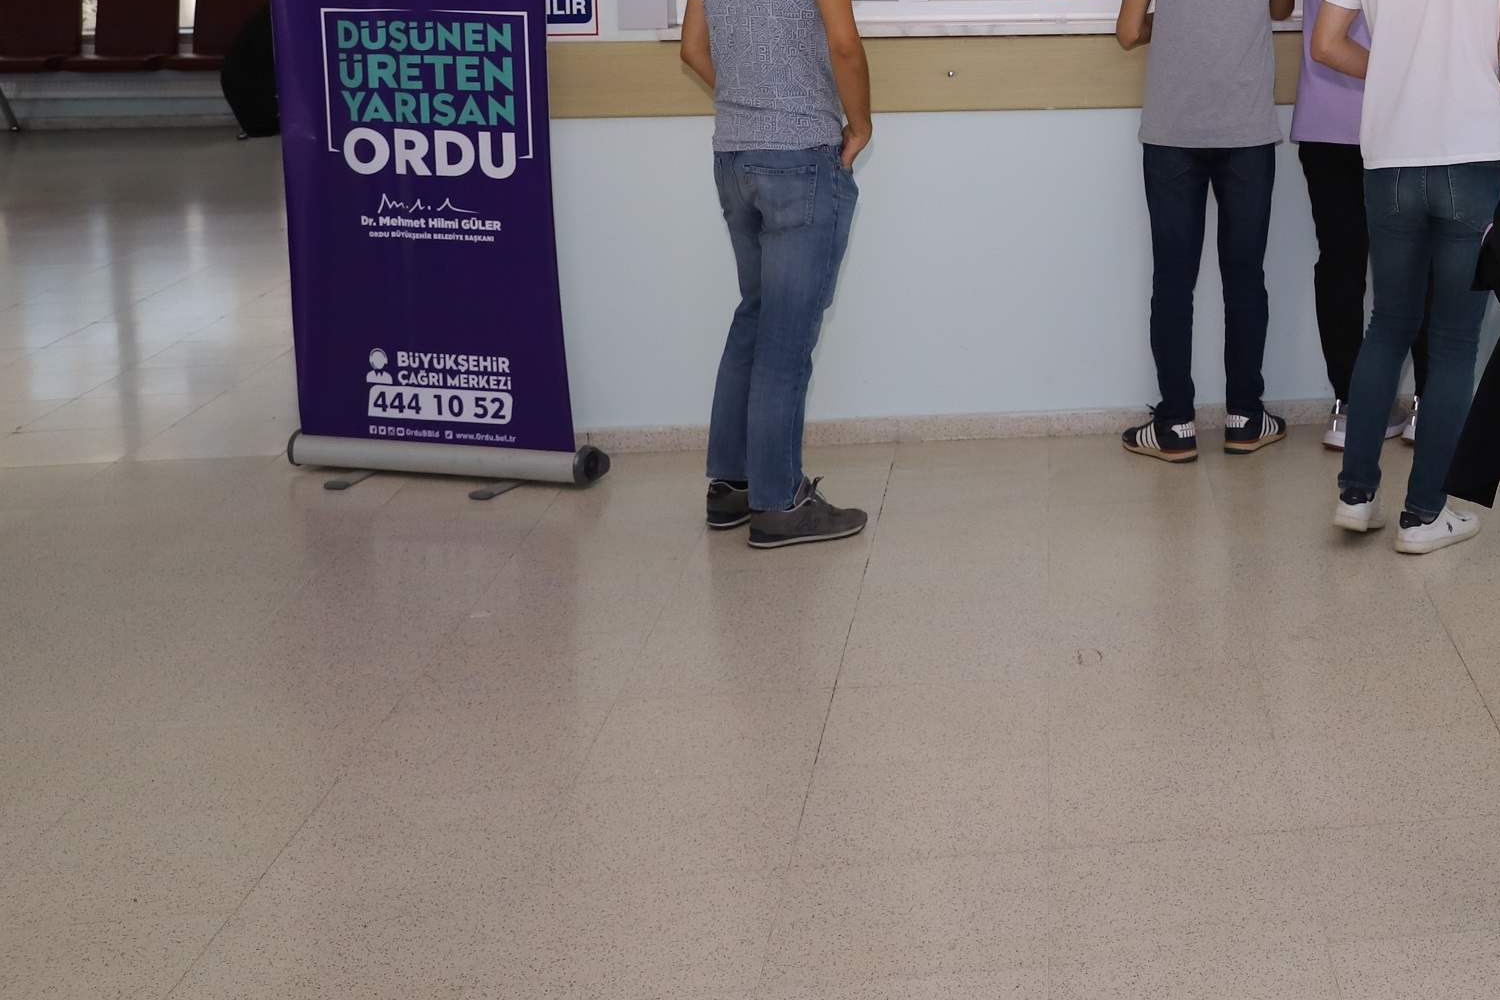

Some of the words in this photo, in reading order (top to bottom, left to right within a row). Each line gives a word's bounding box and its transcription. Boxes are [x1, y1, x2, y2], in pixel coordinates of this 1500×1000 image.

[338, 53, 514, 92] ÜRETEN
[343, 127, 517, 180] ORDU
[361, 216, 377, 227] Dr.
[379, 216, 426, 229] Mehmet
[428, 218, 459, 230] Hilmi
[461, 217, 501, 231] GÜLER
[397, 351, 510, 373] BÜYÜKŞEHİR
[398, 370, 443, 385] ÇAĞRI
[446, 373, 512, 390] MERKEZİ
[373, 391, 421, 415] 444
[433, 394, 464, 417] 10
[473, 396, 506, 420] 52
